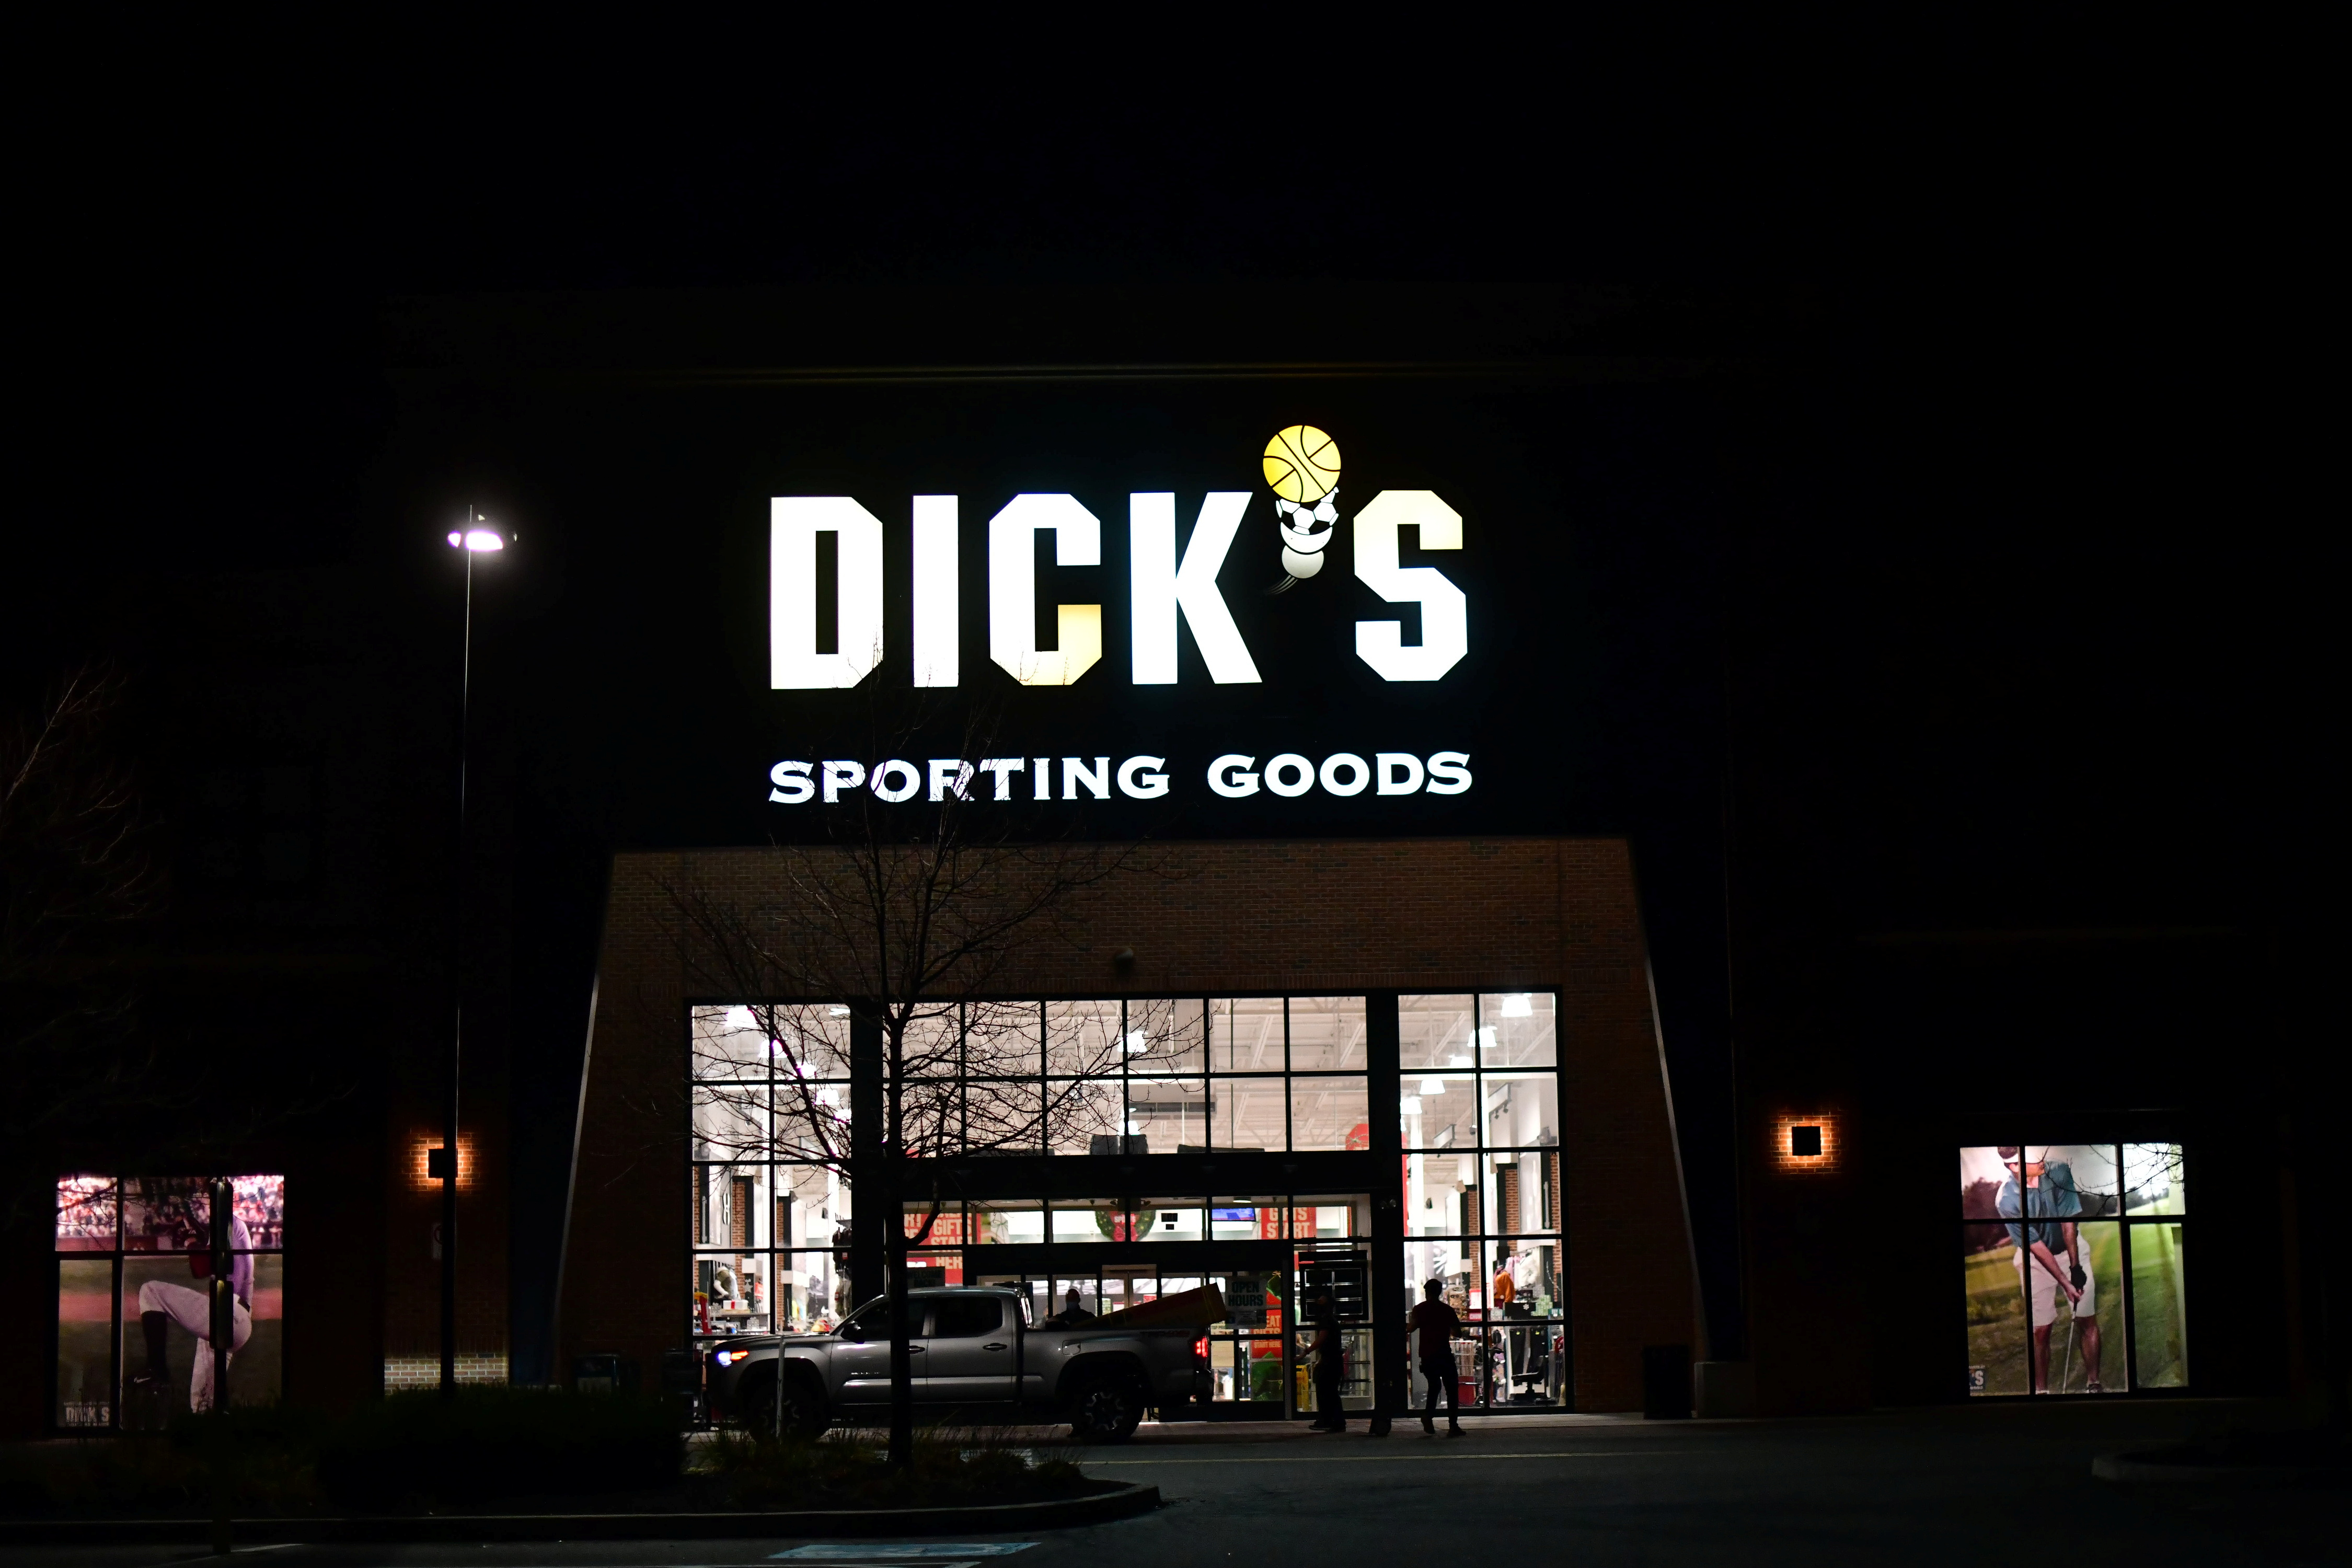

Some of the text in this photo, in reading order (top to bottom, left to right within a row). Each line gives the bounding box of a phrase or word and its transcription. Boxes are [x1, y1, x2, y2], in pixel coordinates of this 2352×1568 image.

[770, 425, 1468, 689] DICK'S
[768, 751, 1473, 803] SPORTING GOODS
[1266, 1222, 1310, 1239] SART
[936, 1256, 963, 1269] HER
[1231, 1282, 1259, 1293] OPEN
[1228, 1295, 1264, 1306] HOURS
[66, 1406, 110, 1422] DICKS
